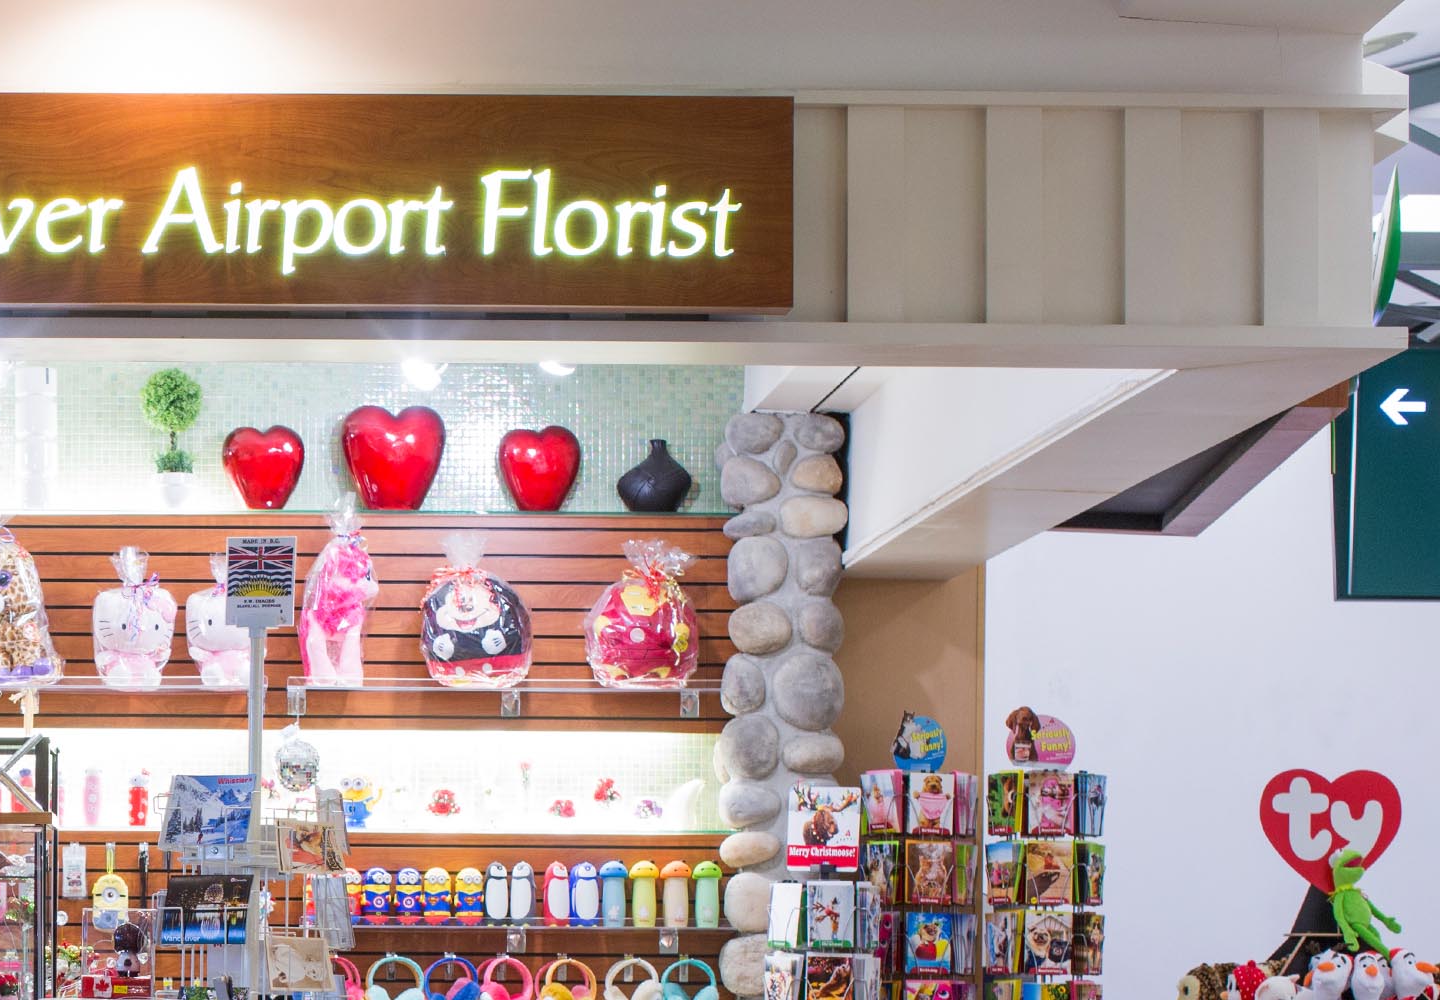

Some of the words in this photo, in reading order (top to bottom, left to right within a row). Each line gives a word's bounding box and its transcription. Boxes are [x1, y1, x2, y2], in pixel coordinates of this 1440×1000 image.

[140, 166, 453, 276] Airport
[481, 168, 742, 258] Florist
[912, 728, 943, 742] Seriously
[1031, 727, 1071, 740] Seriously
[920, 739, 944, 753] Funny!
[1271, 776, 1384, 862] ty
[789, 846, 810, 858] Merry
[810, 847, 856, 857] Christmoose!
